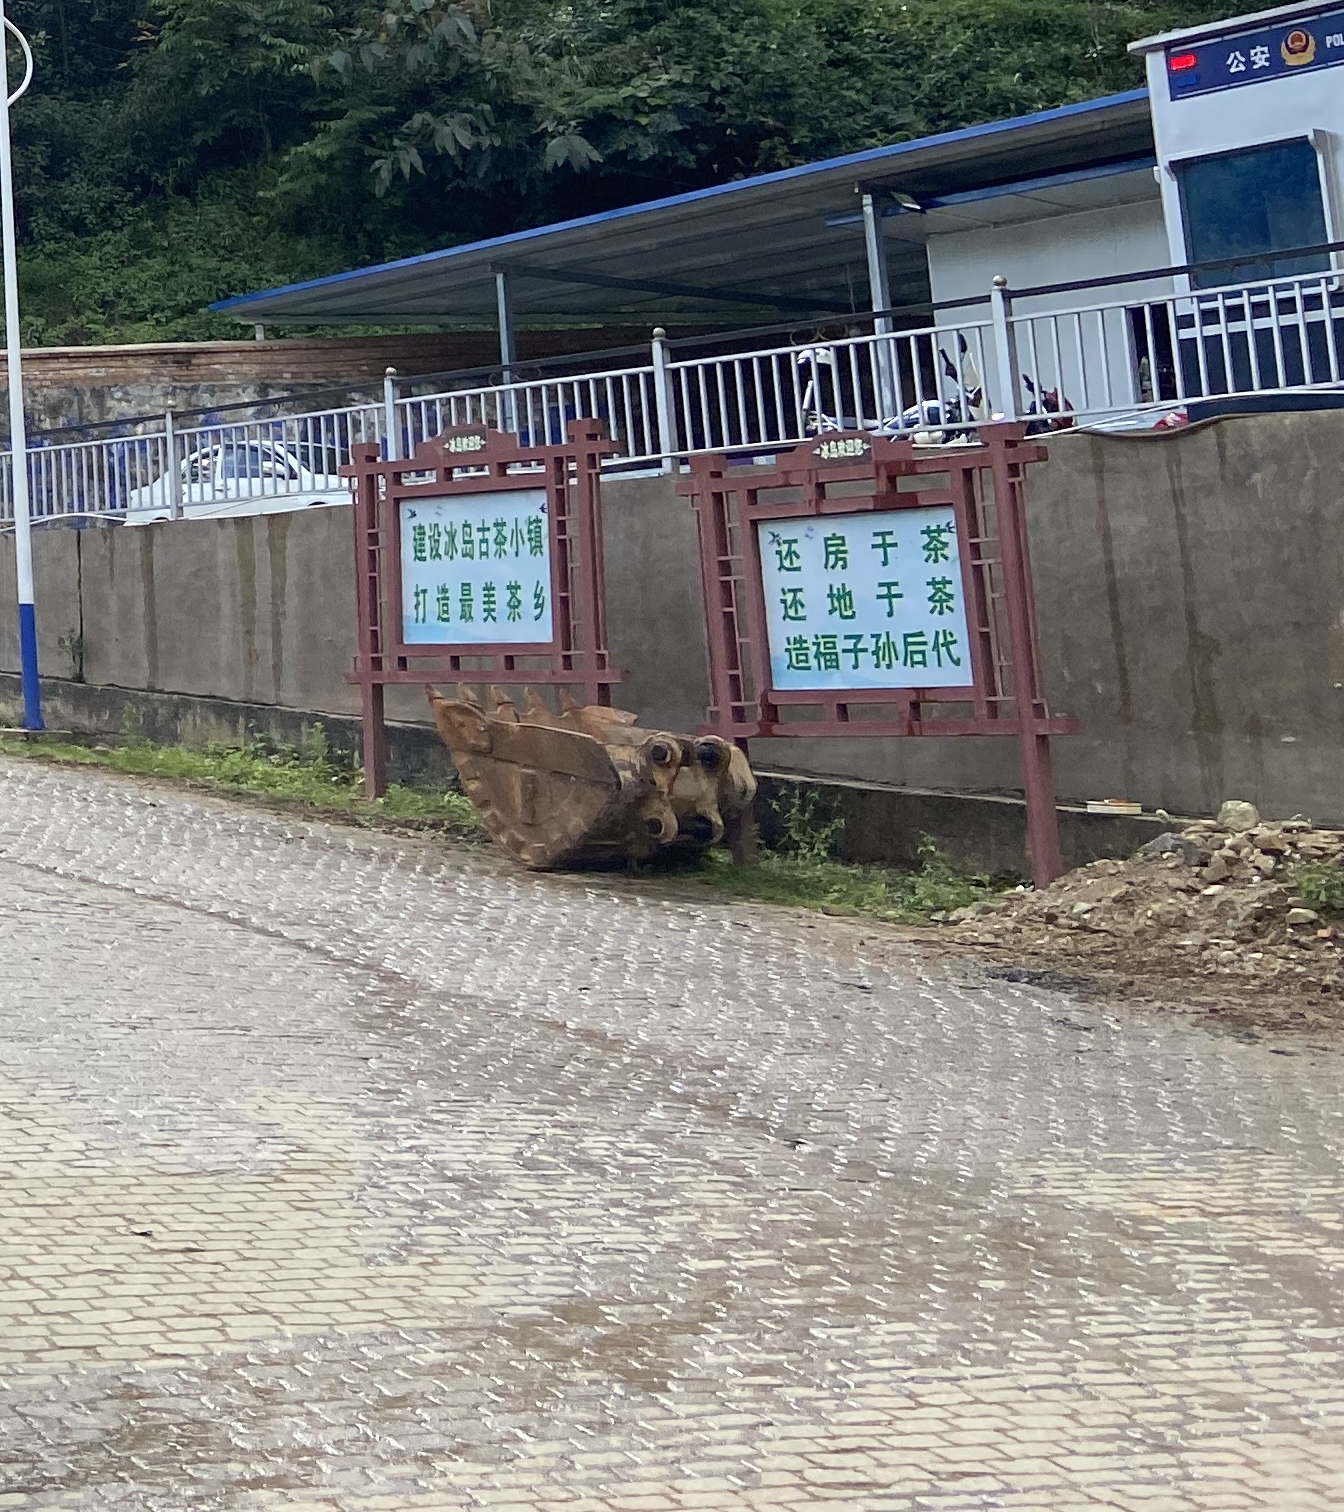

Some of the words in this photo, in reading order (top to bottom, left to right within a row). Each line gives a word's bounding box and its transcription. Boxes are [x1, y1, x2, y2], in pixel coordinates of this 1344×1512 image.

[1226, 45, 1270, 73] 公安
[413, 515, 544, 562] 建设冰岛古茶小镇
[414, 580, 546, 624] 打造最美茶乡
[785, 629, 961, 671] 造福子孙后代
